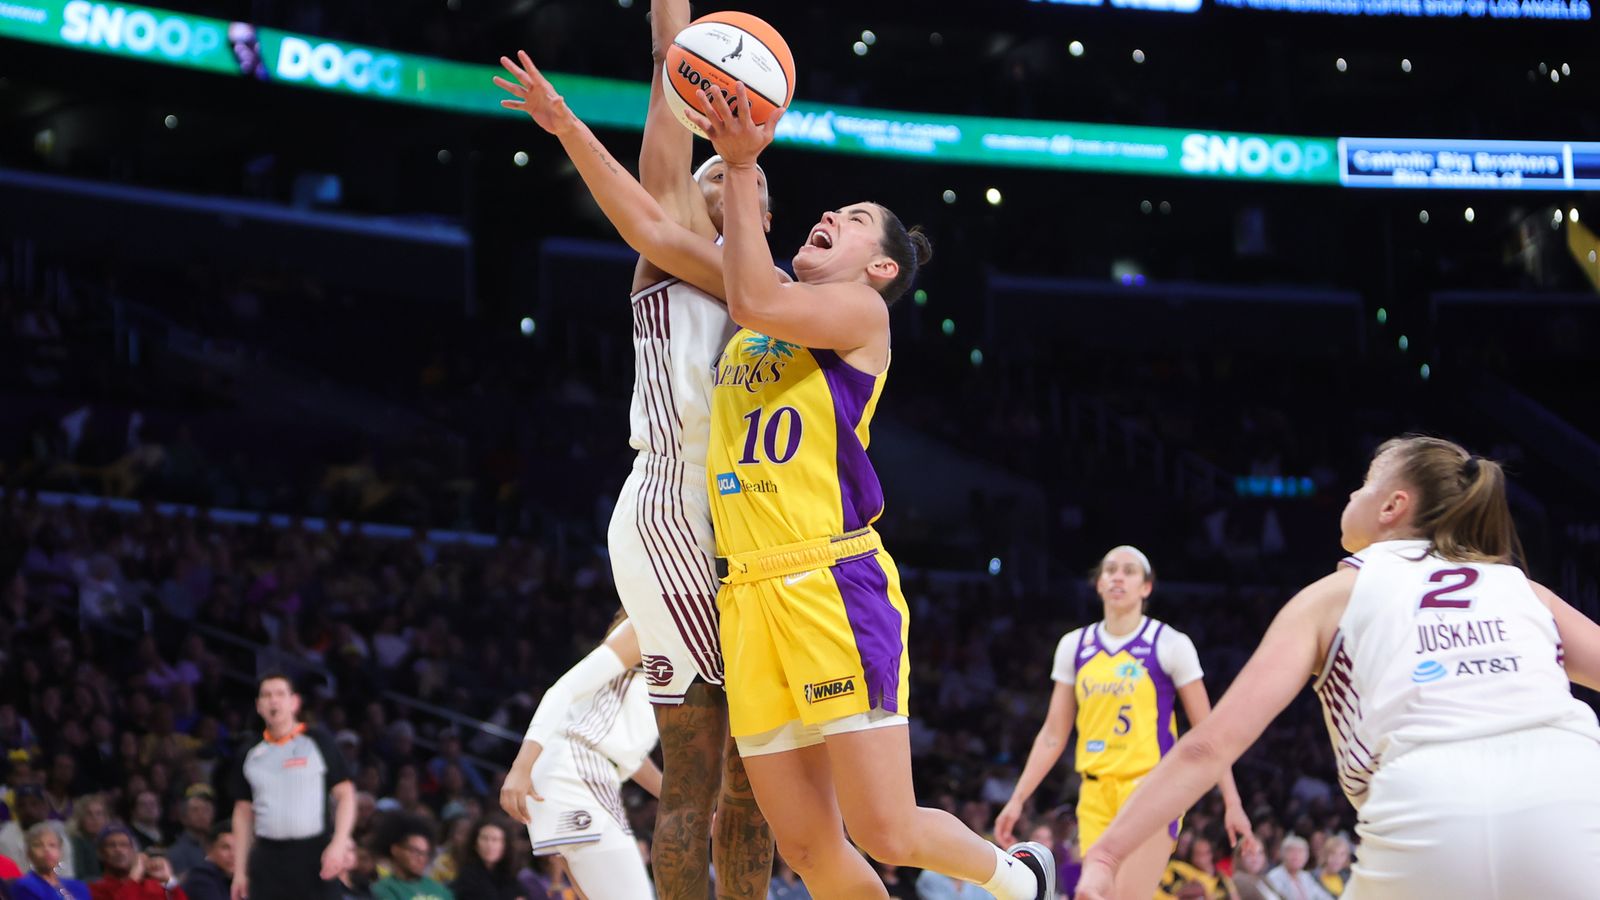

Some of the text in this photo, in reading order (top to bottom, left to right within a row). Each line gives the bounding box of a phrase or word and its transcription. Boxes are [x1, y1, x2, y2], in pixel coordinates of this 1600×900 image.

[60, 0, 219, 62] SNOOP
[276, 37, 400, 95] DOGG
[1180, 133, 1329, 180] SNOOP
[737, 405, 803, 465] 10
[718, 477, 736, 491] UCLA
[1418, 566, 1480, 609] 2
[1455, 655, 1522, 677] AT&T
[813, 678, 855, 700] WNBA
[1113, 704, 1132, 736] 5
